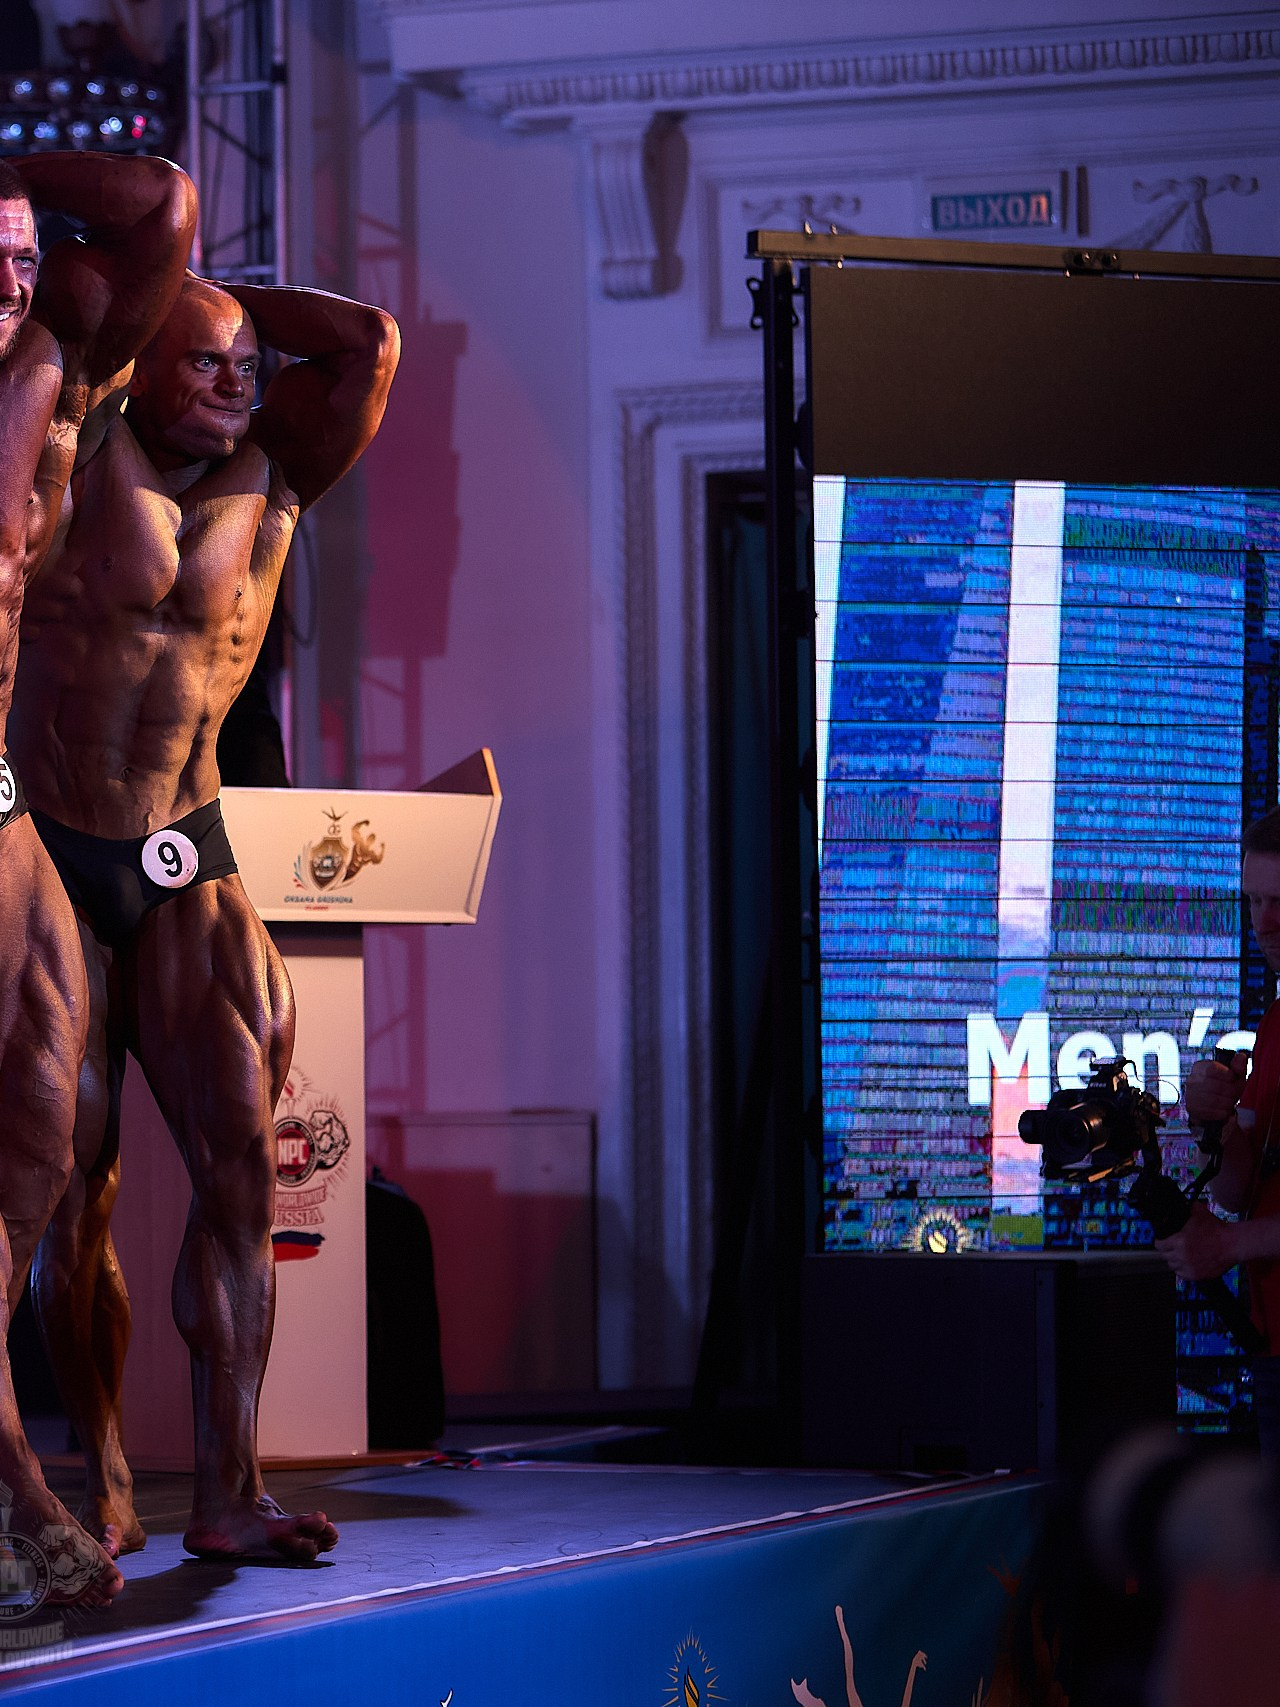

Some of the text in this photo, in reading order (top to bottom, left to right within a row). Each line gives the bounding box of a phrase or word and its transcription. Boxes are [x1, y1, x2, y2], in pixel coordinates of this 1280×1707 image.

[939, 194, 1049, 226] ВЫХОД
[157, 841, 183, 878] 9
[277, 1137, 308, 1166] NPC
